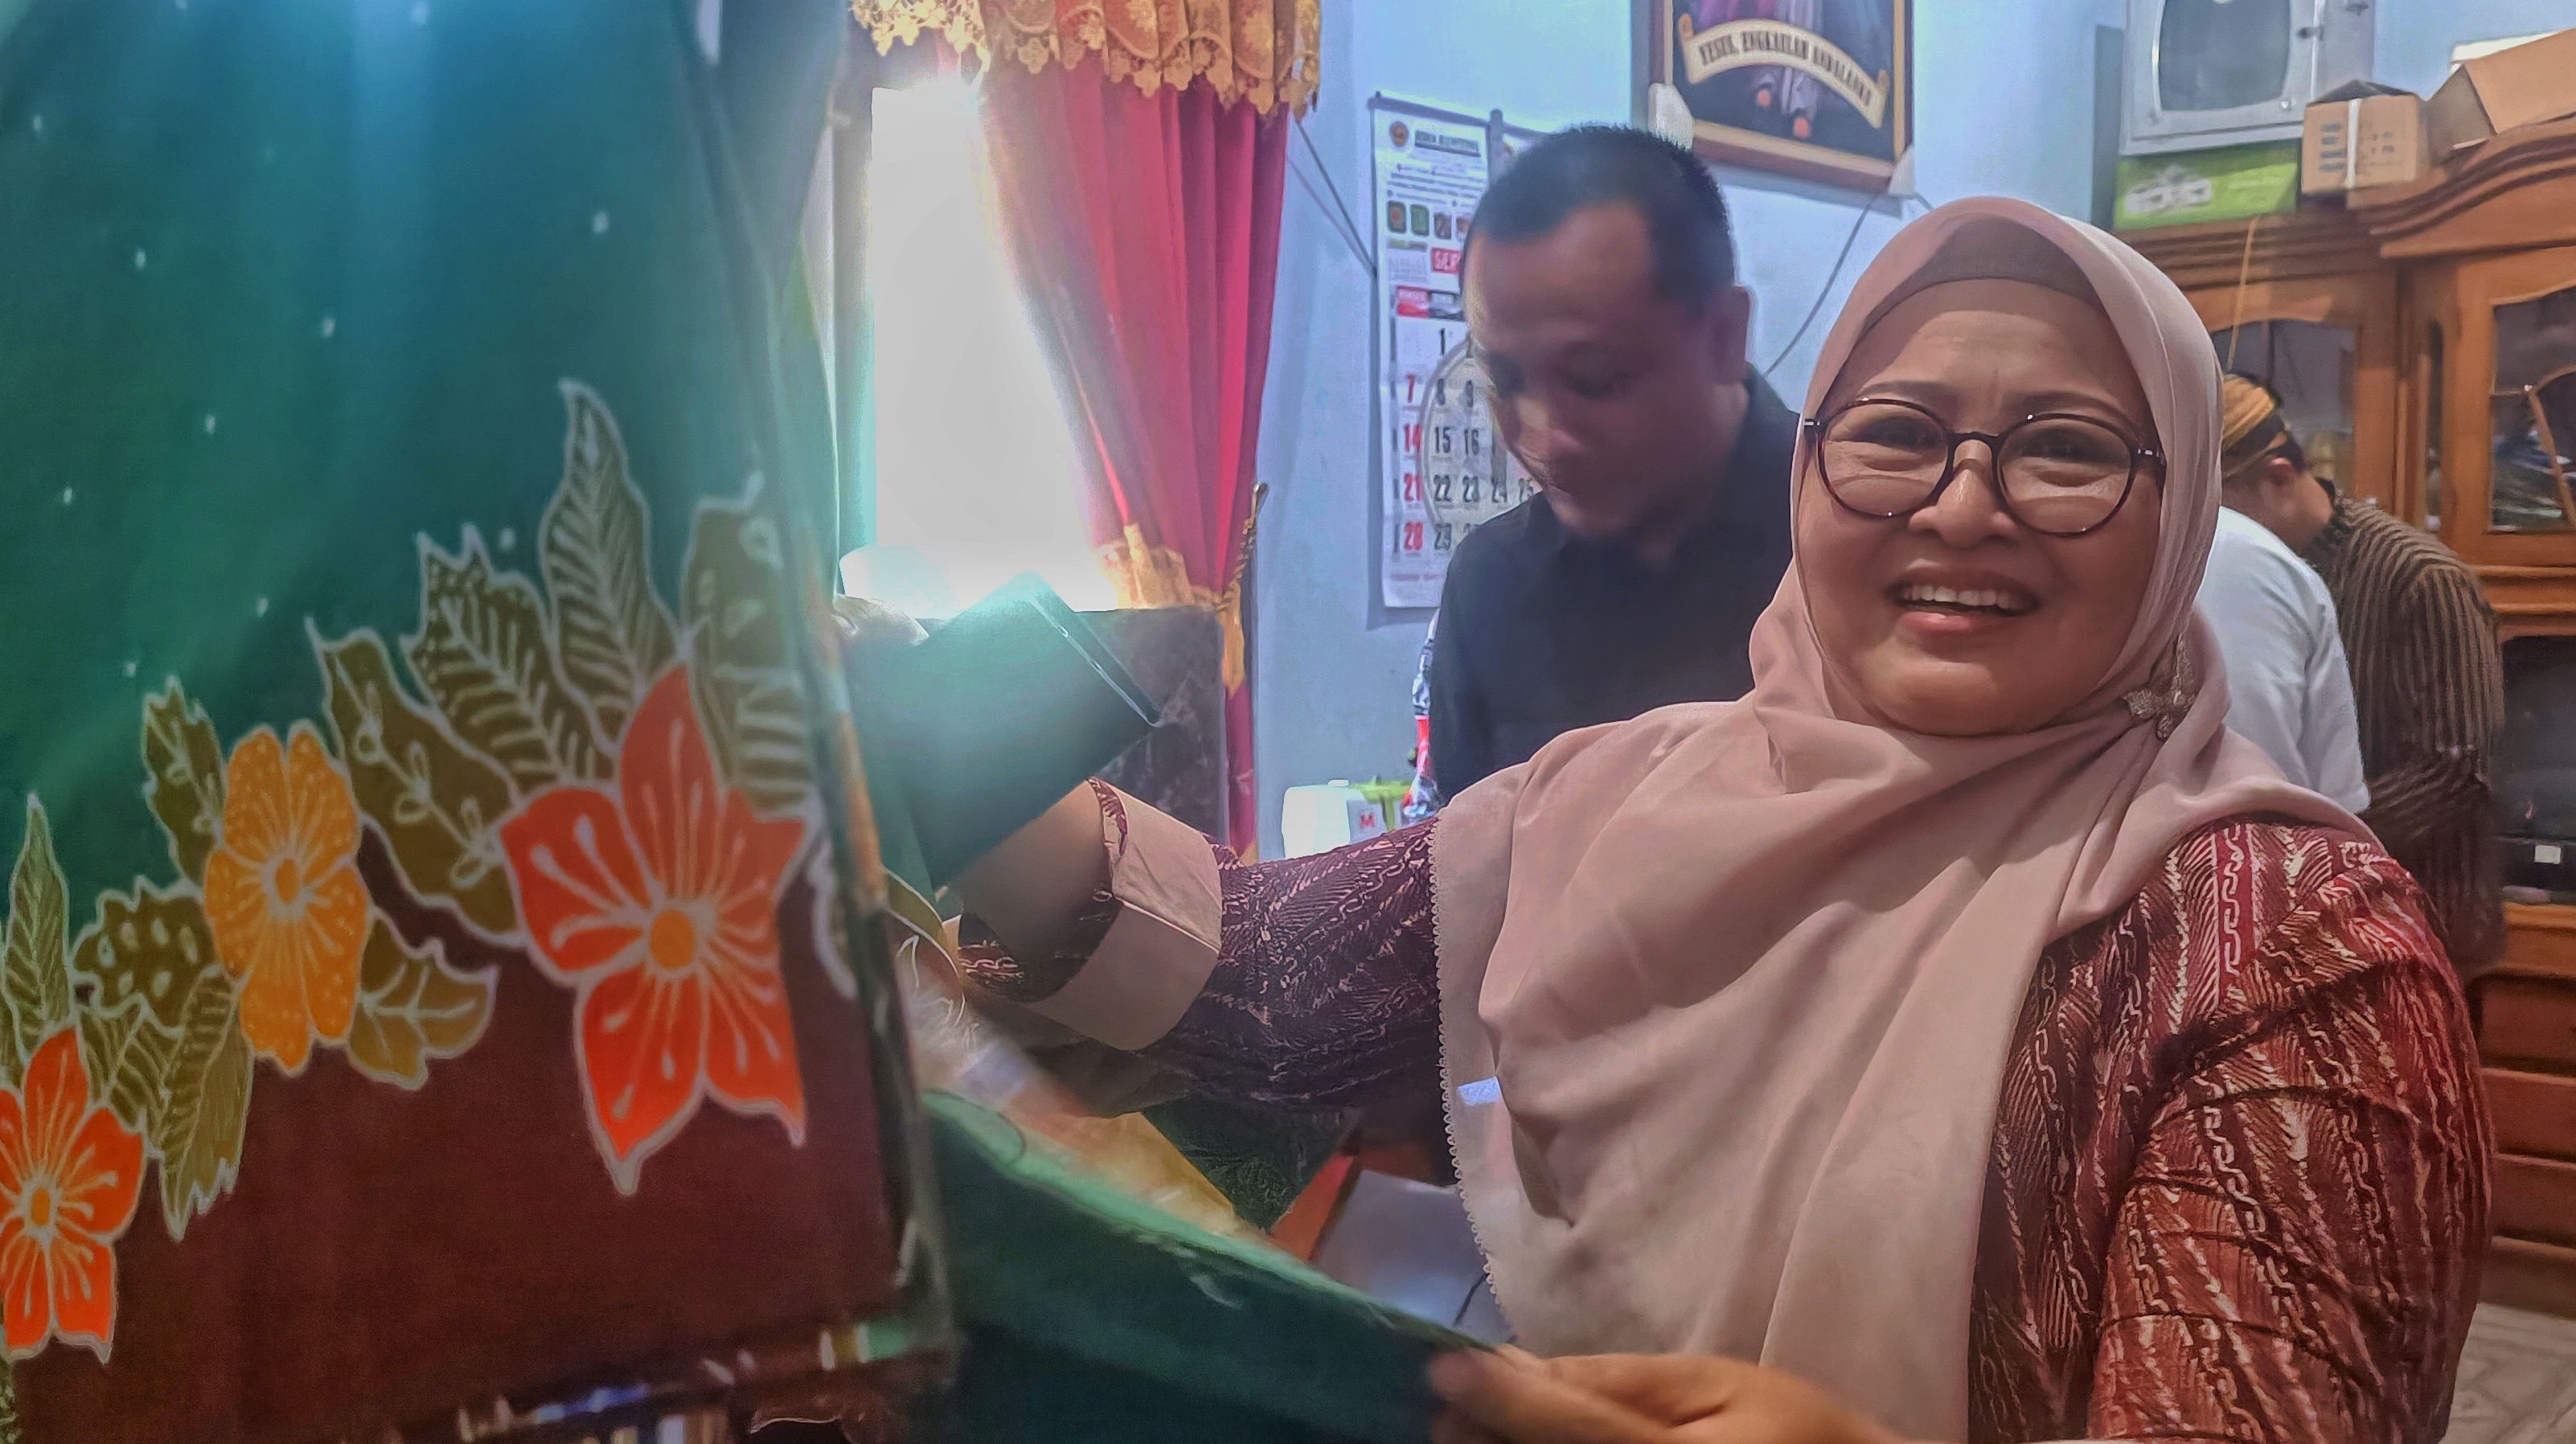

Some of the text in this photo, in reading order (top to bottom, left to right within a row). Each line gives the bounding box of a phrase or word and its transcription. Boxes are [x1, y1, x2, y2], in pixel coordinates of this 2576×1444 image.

[1440, 328, 1446, 355] 1
[1405, 375, 1475, 408] 7 8 9
[1403, 423, 1422, 453] 14
[1434, 426, 1451, 453] 15
[1463, 429, 1480, 456] 16
[1403, 471, 1423, 503] 21
[1433, 474, 1452, 503] 22
[1462, 475, 1480, 503] 23
[1491, 475, 1508, 503] 24
[1404, 522, 1453, 551] 28 29
